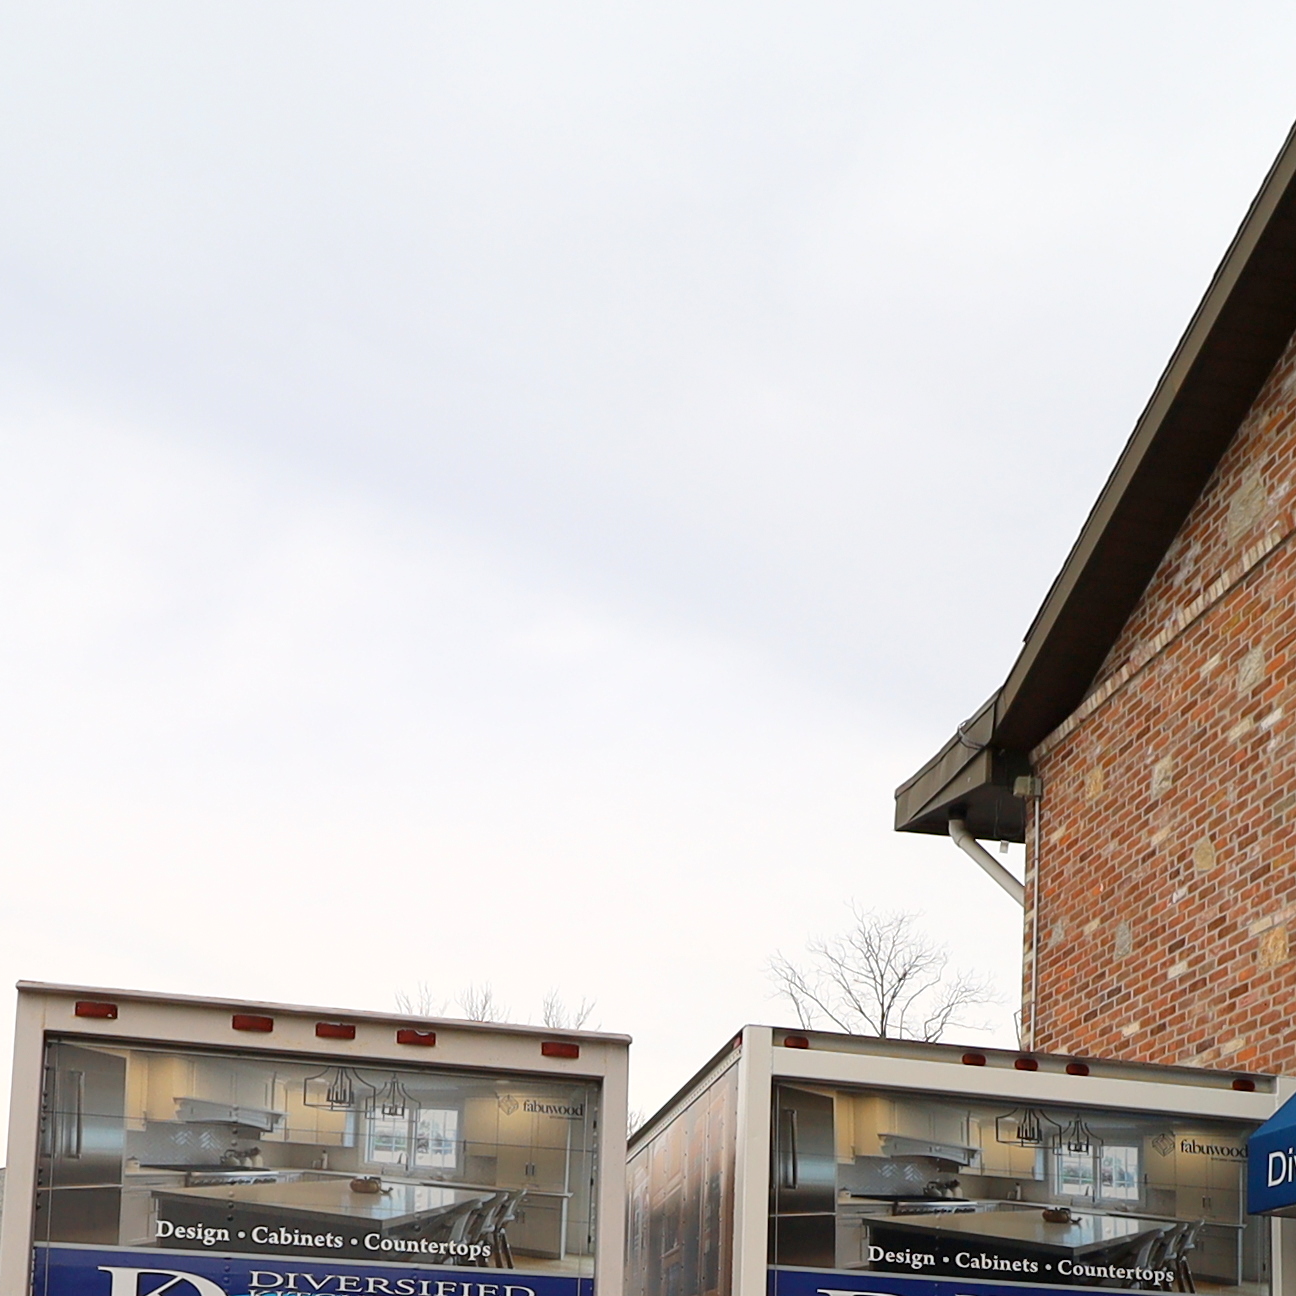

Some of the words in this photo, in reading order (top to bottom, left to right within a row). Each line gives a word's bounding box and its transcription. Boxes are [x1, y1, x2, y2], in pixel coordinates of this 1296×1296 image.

[523, 1099, 584, 1117] fabuwood
[1180, 1138, 1249, 1158] fabuwood
[155, 1219, 230, 1245] Design
[251, 1225, 344, 1250] Cabinets
[364, 1232, 492, 1260] Countertops
[867, 1244, 936, 1270] Design
[955, 1251, 1039, 1275] Cabinets
[1057, 1258, 1176, 1287] Countertops
